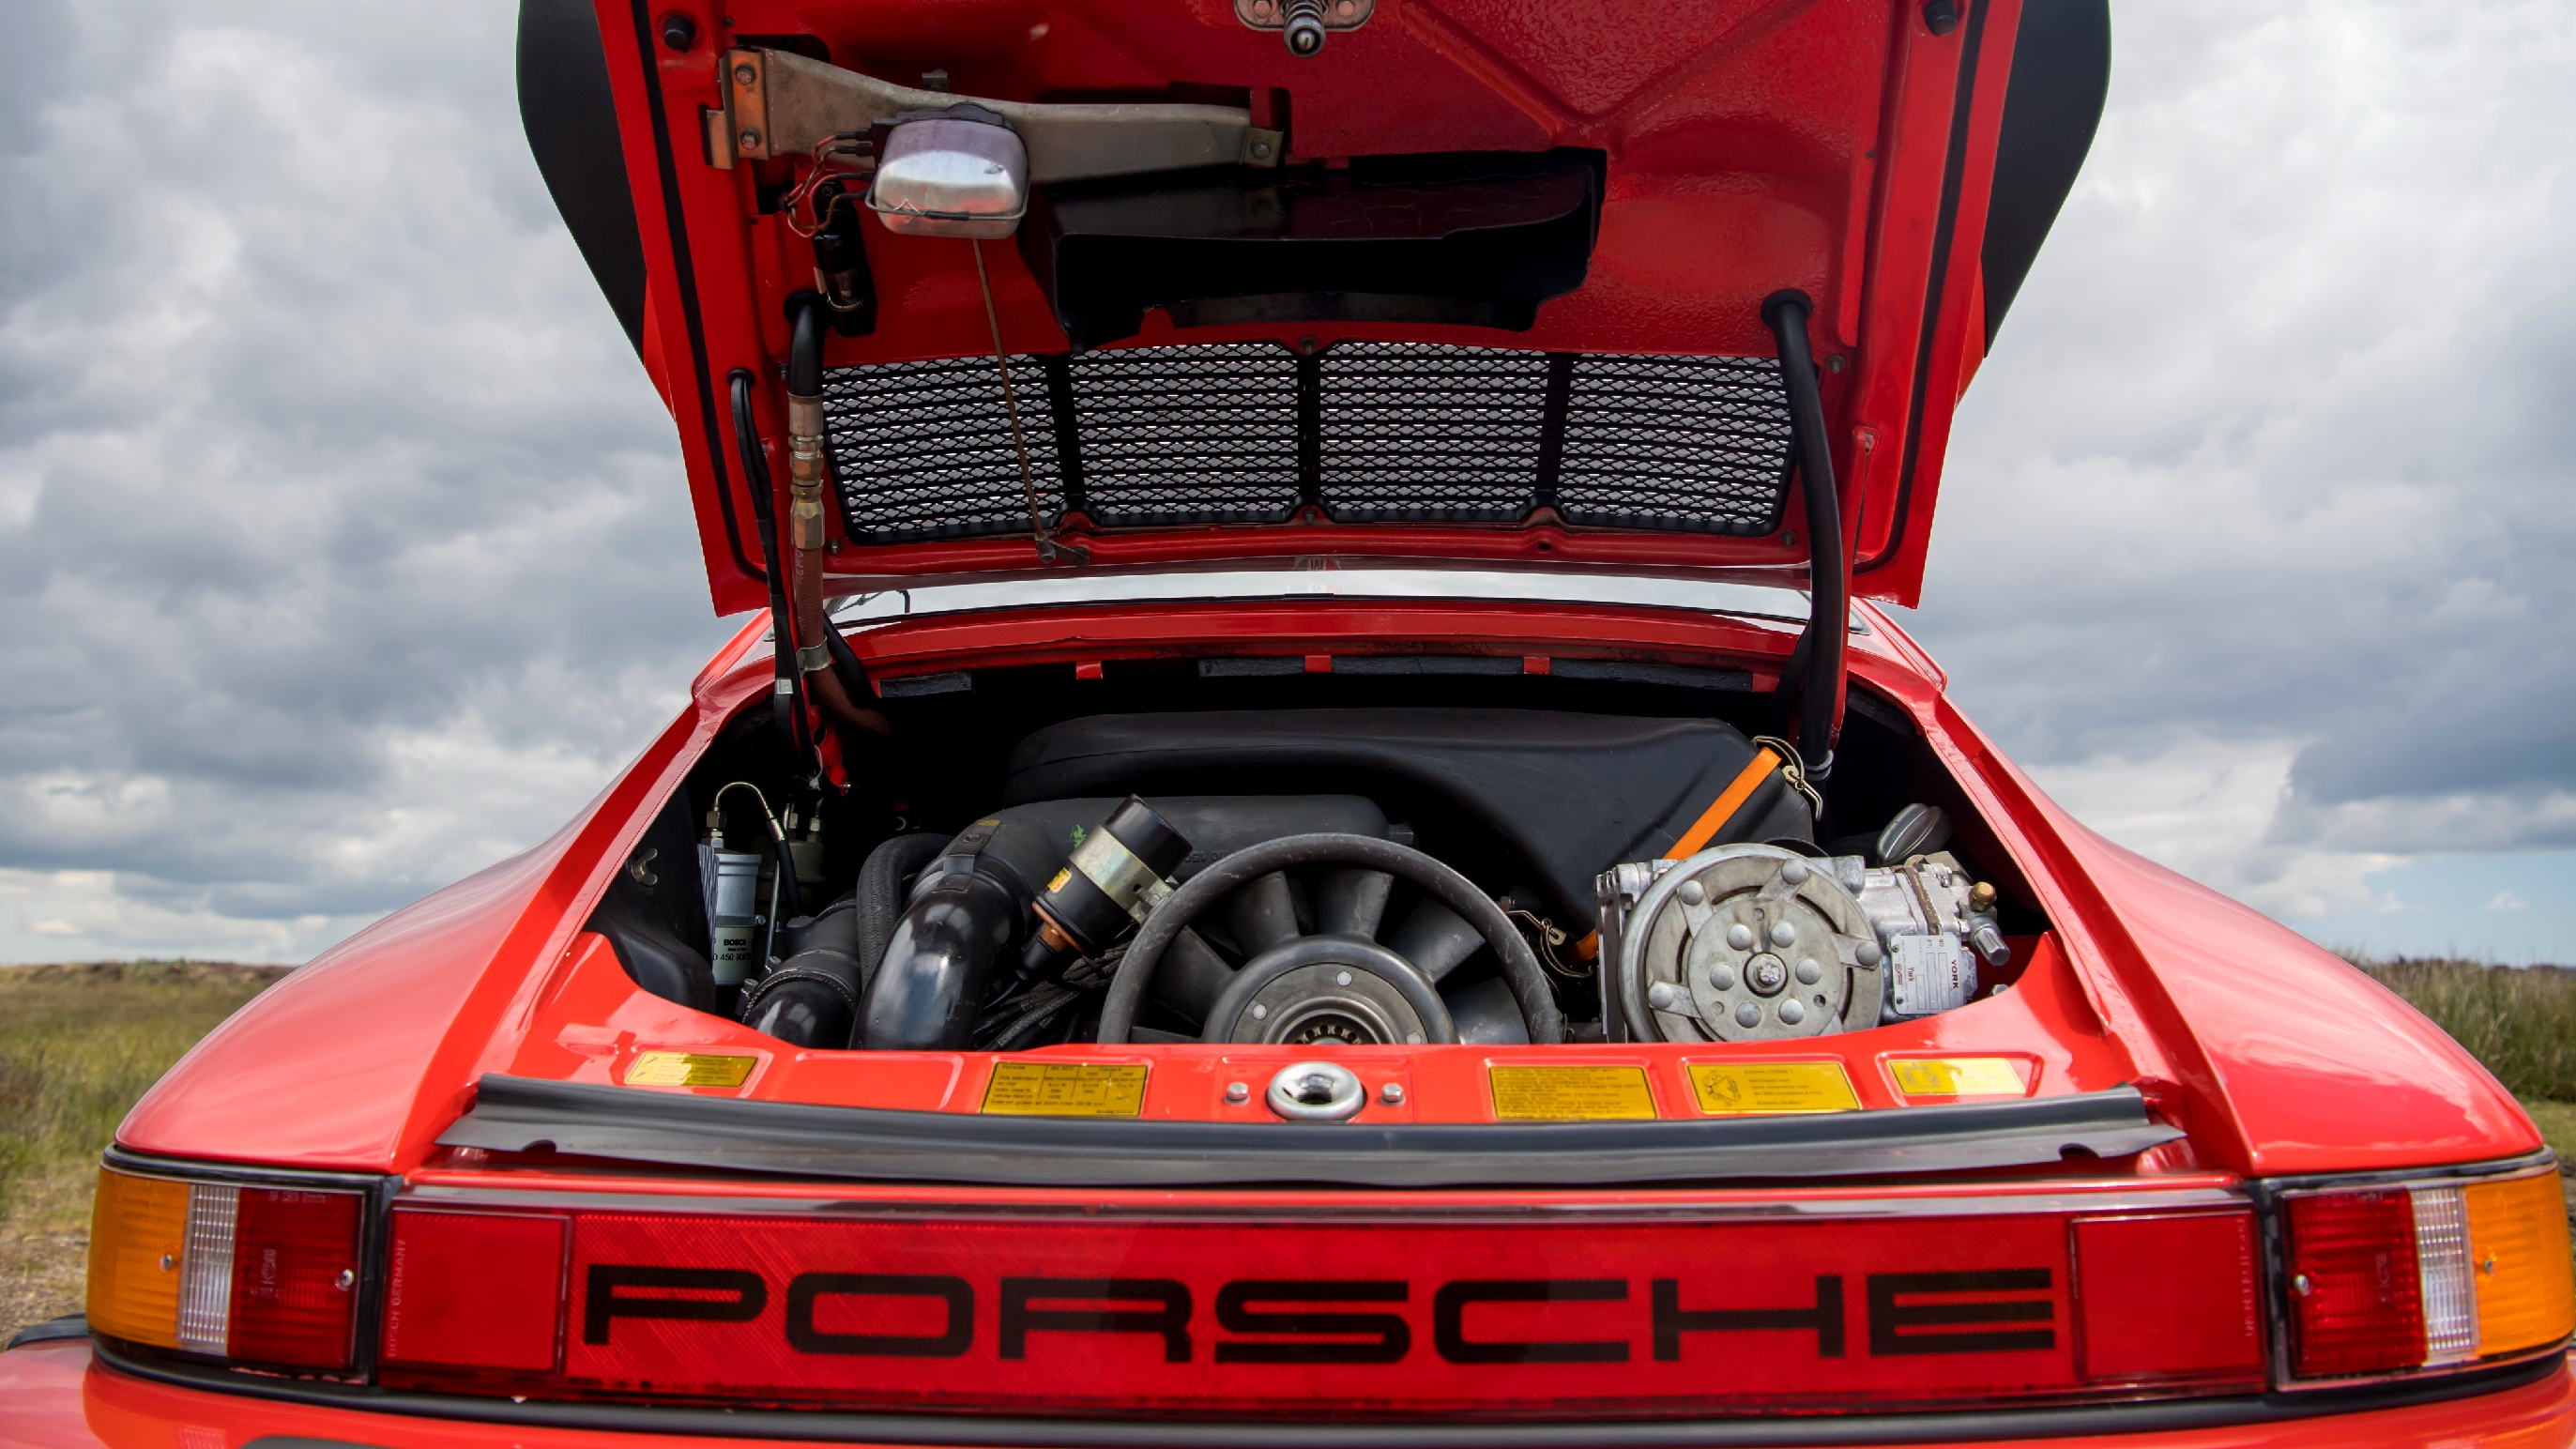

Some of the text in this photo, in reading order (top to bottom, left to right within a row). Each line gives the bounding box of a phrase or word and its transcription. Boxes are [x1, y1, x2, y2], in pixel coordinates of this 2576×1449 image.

[388, 1239, 406, 1357] BOSCH GERMANY
[584, 1264, 2055, 1365] PORSCHE
